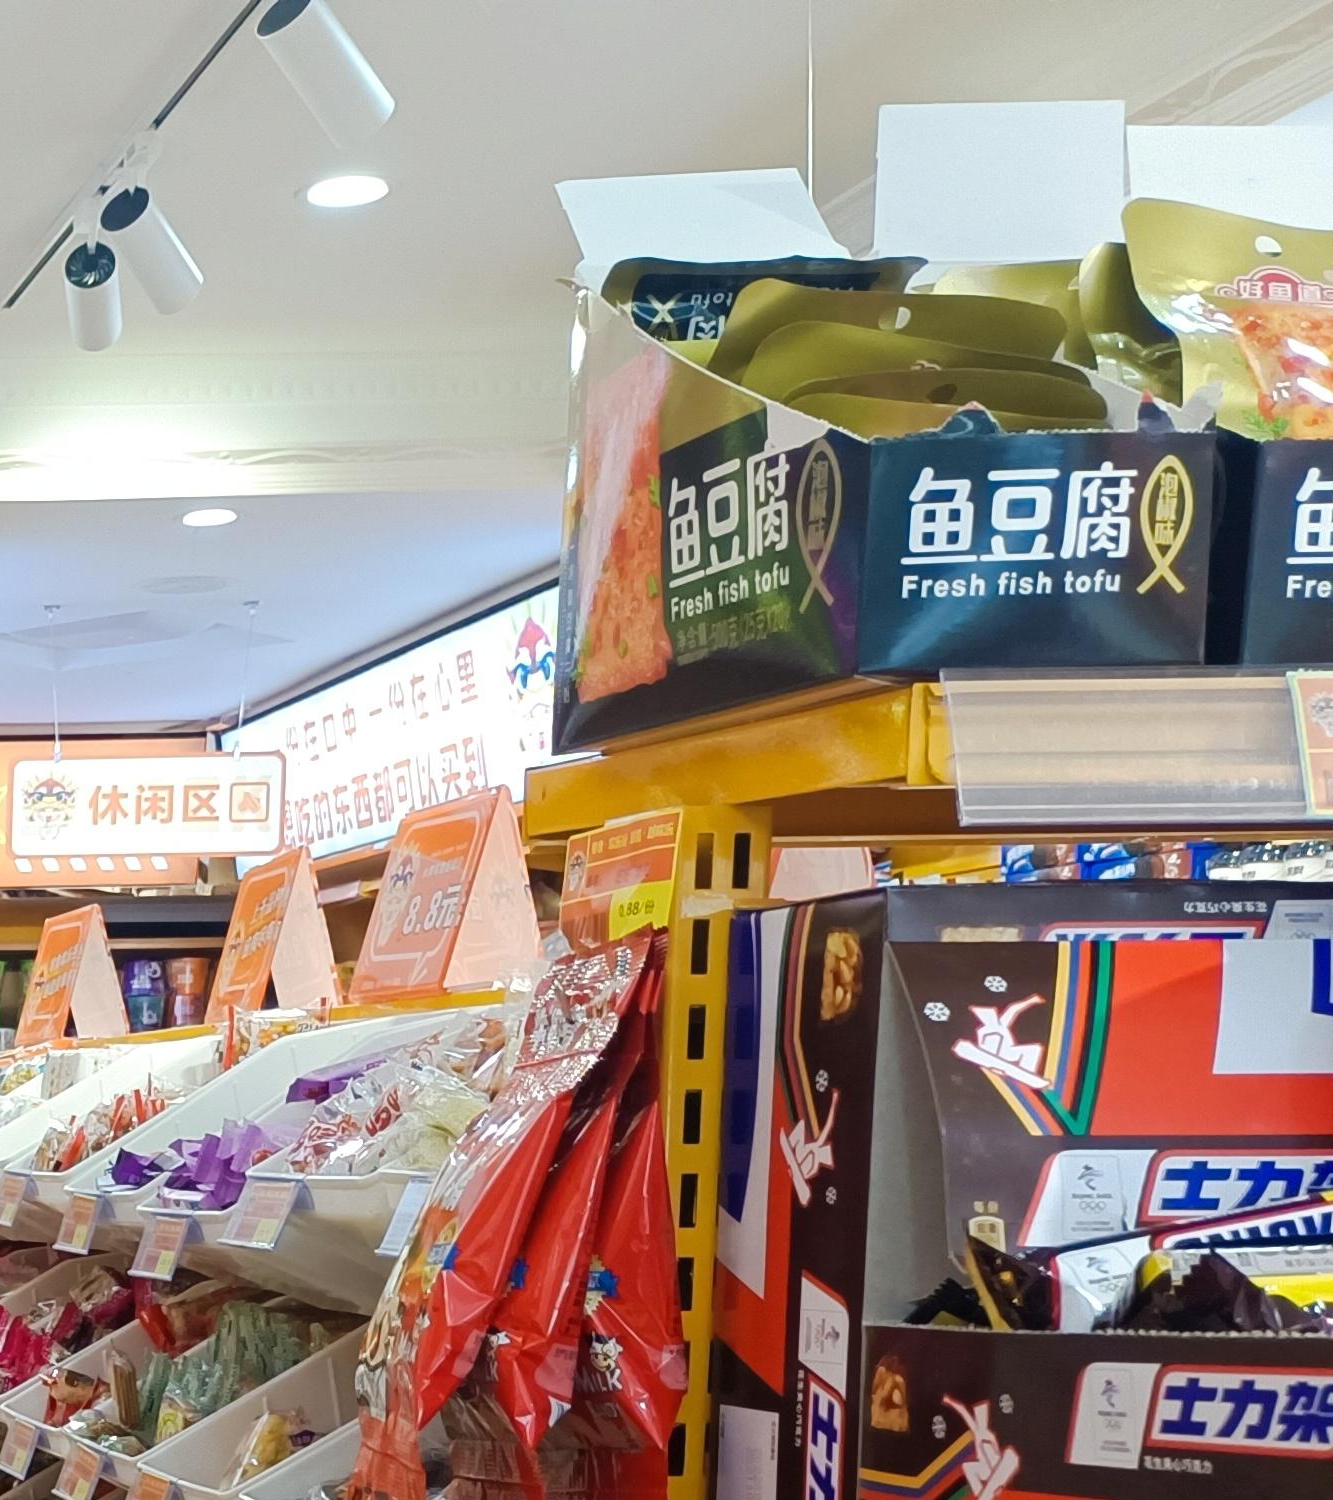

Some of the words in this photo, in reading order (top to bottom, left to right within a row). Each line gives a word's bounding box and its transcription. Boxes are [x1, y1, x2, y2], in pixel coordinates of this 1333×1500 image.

[667, 447, 791, 589] 鱼豆腐
[899, 461, 1138, 566] 鱼豆腐
[671, 590, 714, 622] Fresh
[718, 579, 749, 612] fish
[754, 563, 791, 596] tofu
[901, 575, 986, 601] Fresh
[997, 570, 1053, 596] fish
[1063, 568, 1121, 595] tofu
[88, 783, 221, 826] 休闲区
